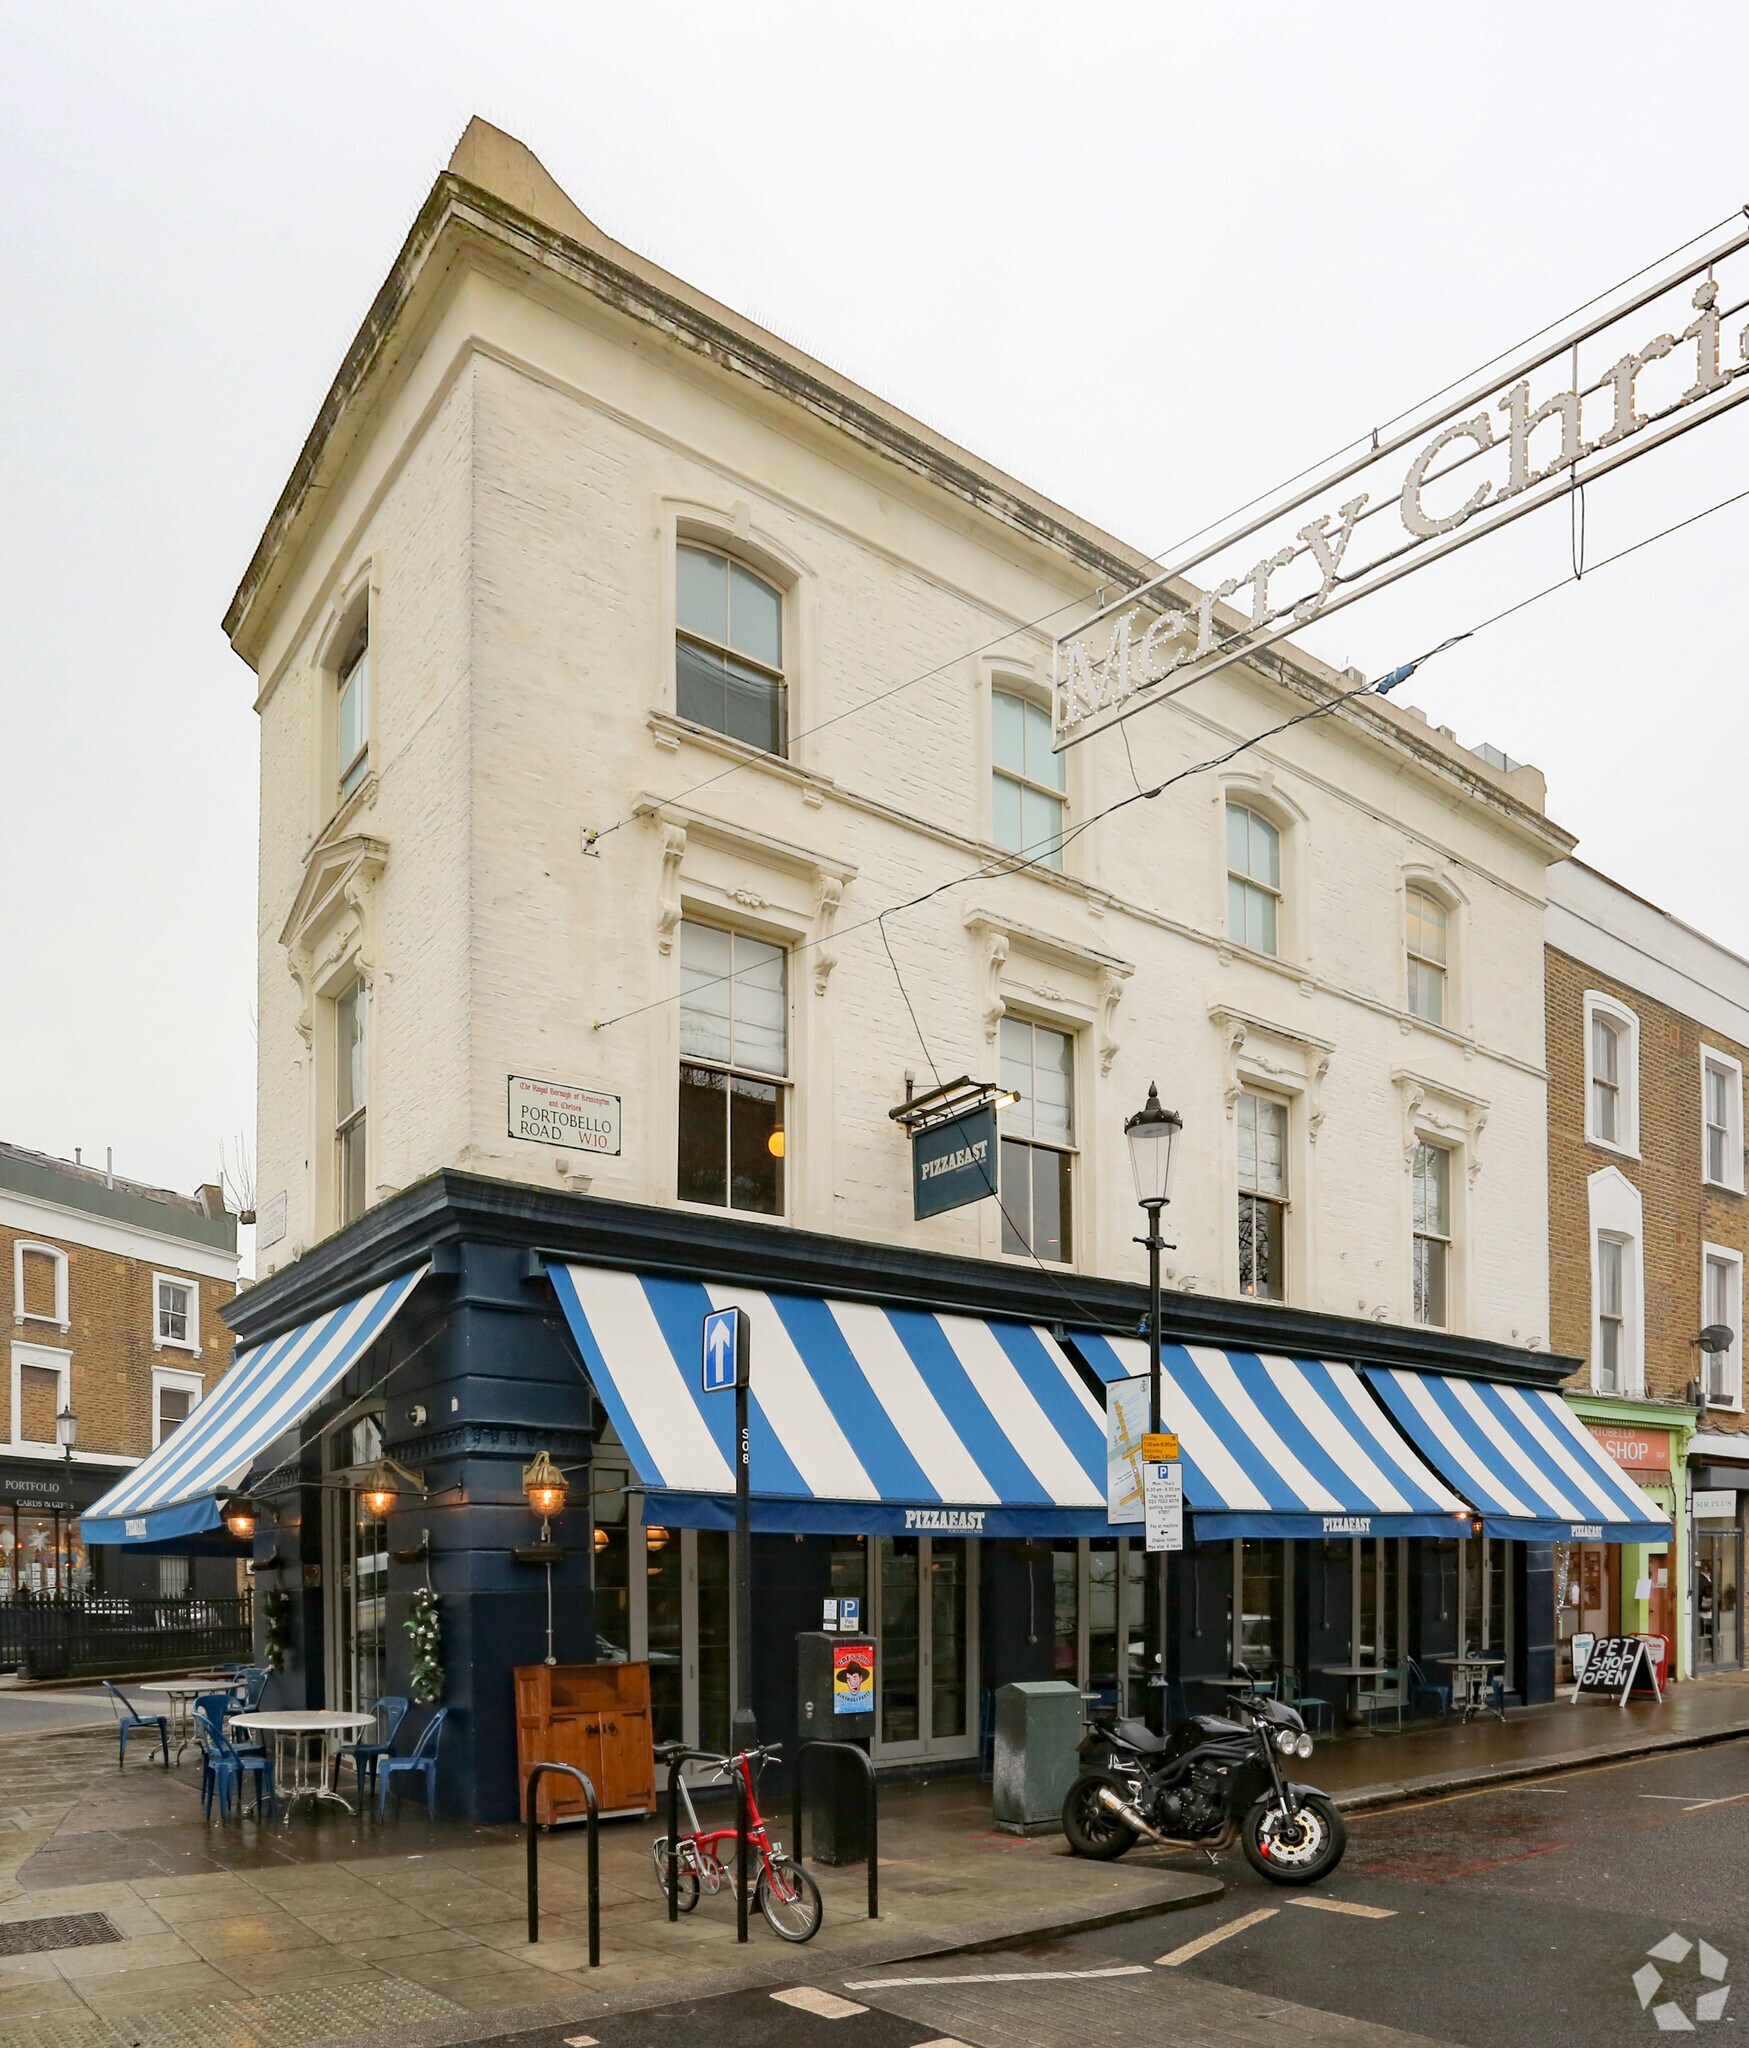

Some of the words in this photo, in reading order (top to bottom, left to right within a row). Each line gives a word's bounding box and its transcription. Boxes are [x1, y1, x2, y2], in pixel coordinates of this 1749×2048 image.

[1058, 493, 1369, 729] Merry
[520, 1081, 530, 1091] The
[532, 1084, 548, 1095] Royal
[550, 1087, 572, 1100] Borough
[582, 1093, 610, 1106] Kensington
[561, 1102, 582, 1112] Chelsea
[521, 1105, 612, 1134] PORTOBELLO
[922, 1140, 988, 1180] PIZZAEAST
[1587, 1424, 1635, 1439] ORTOBELLO
[1605, 1440, 1649, 1460] SHOP
[5, 1480, 60, 1492] PORTFOLIO
[16, 1499, 42, 1508] CARDS
[905, 1510, 986, 1530] PIZZAEAST
[1322, 1517, 1371, 1532] PIZZAEAST
[844, 1600, 856, 1618] P
[1594, 1638, 1634, 1657] PET
[1588, 1655, 1634, 1670] SHOP
[1582, 1670, 1628, 1686] OPEN
